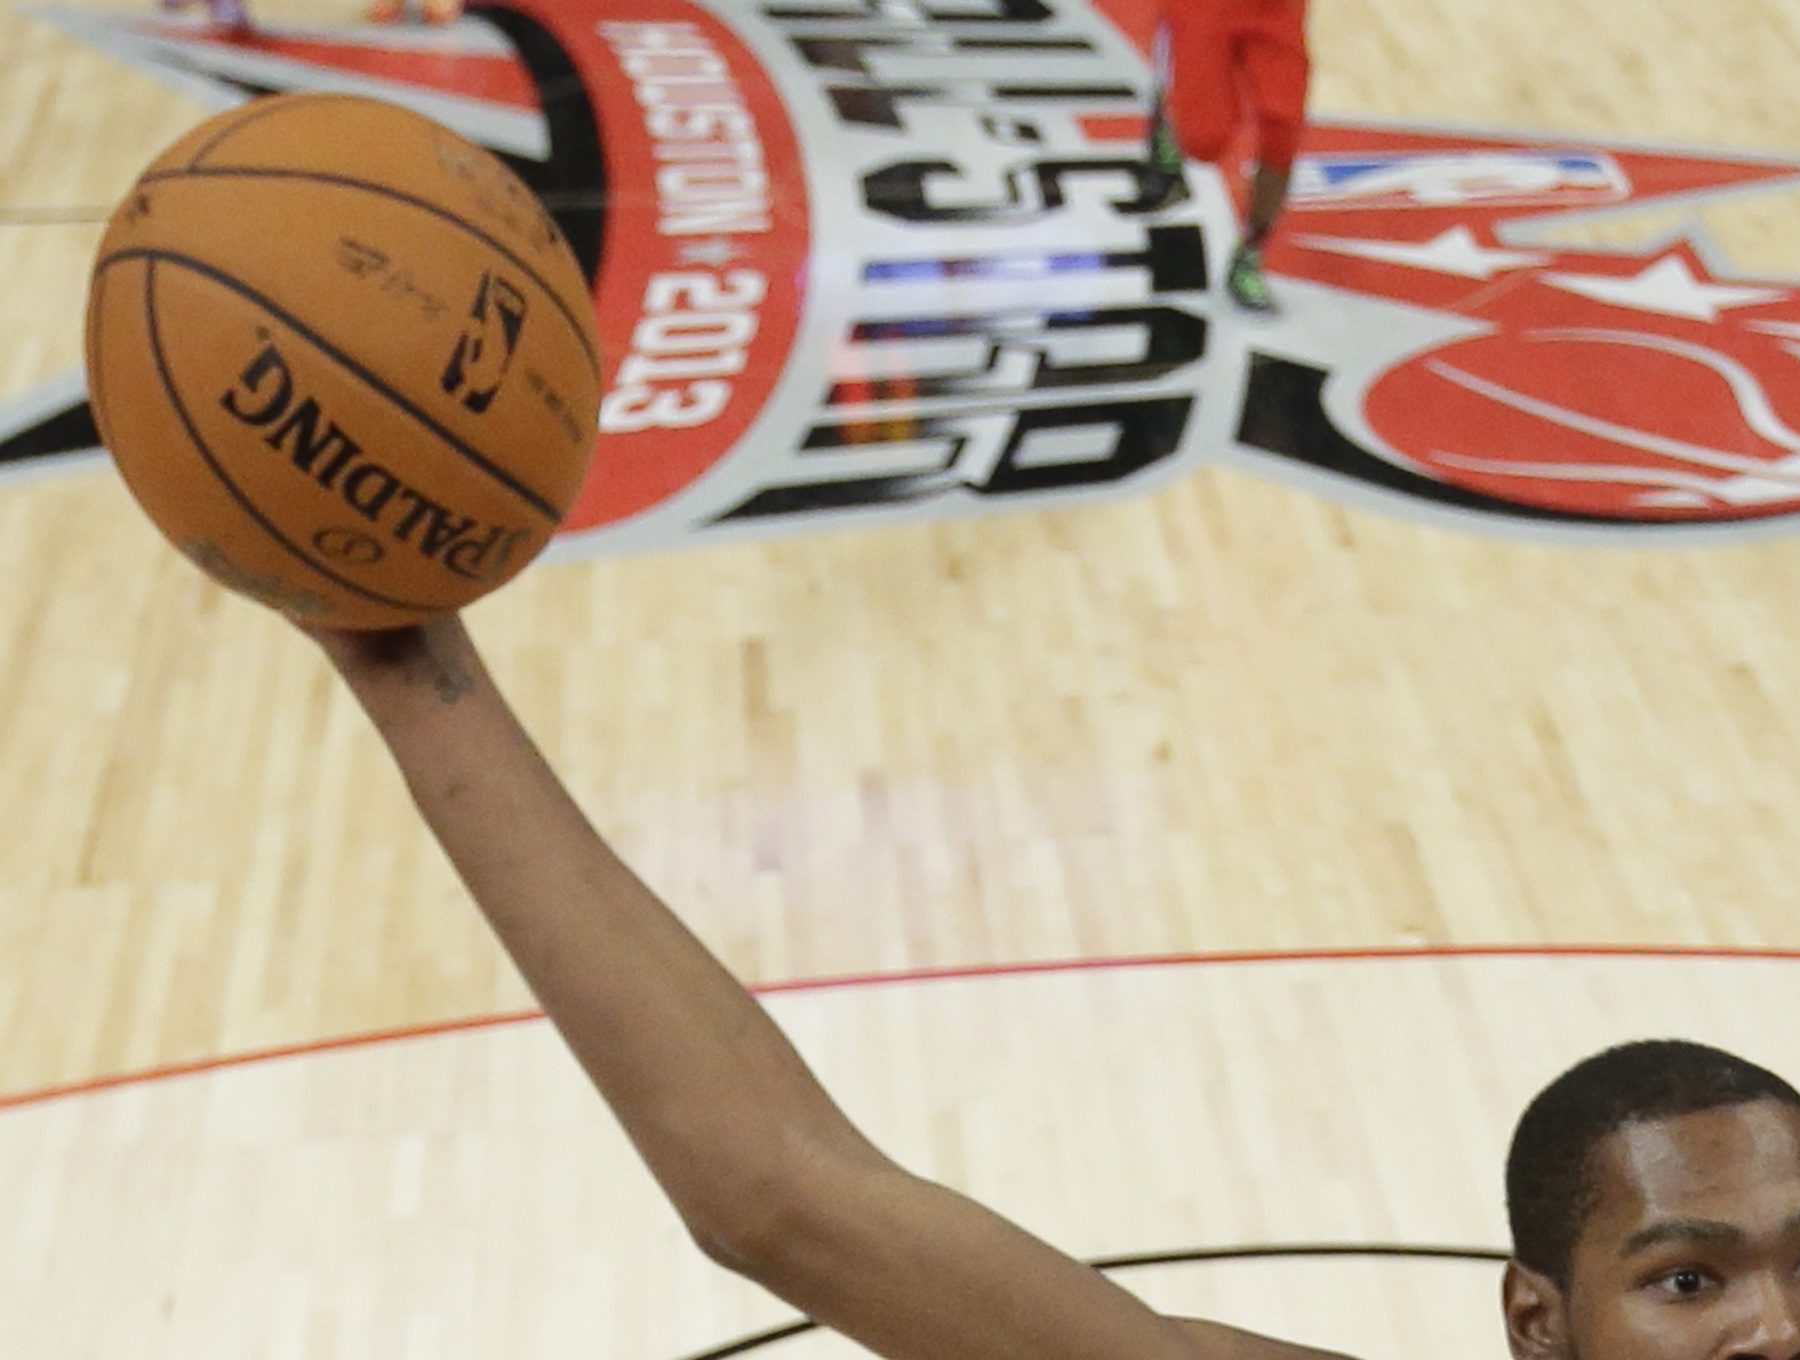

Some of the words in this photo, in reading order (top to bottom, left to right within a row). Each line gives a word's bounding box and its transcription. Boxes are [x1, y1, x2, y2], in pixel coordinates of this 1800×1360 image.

[600, 18, 773, 235] HOUSTON
[597, 270, 768, 434] 2013
[219, 346, 532, 585] SPALDING
